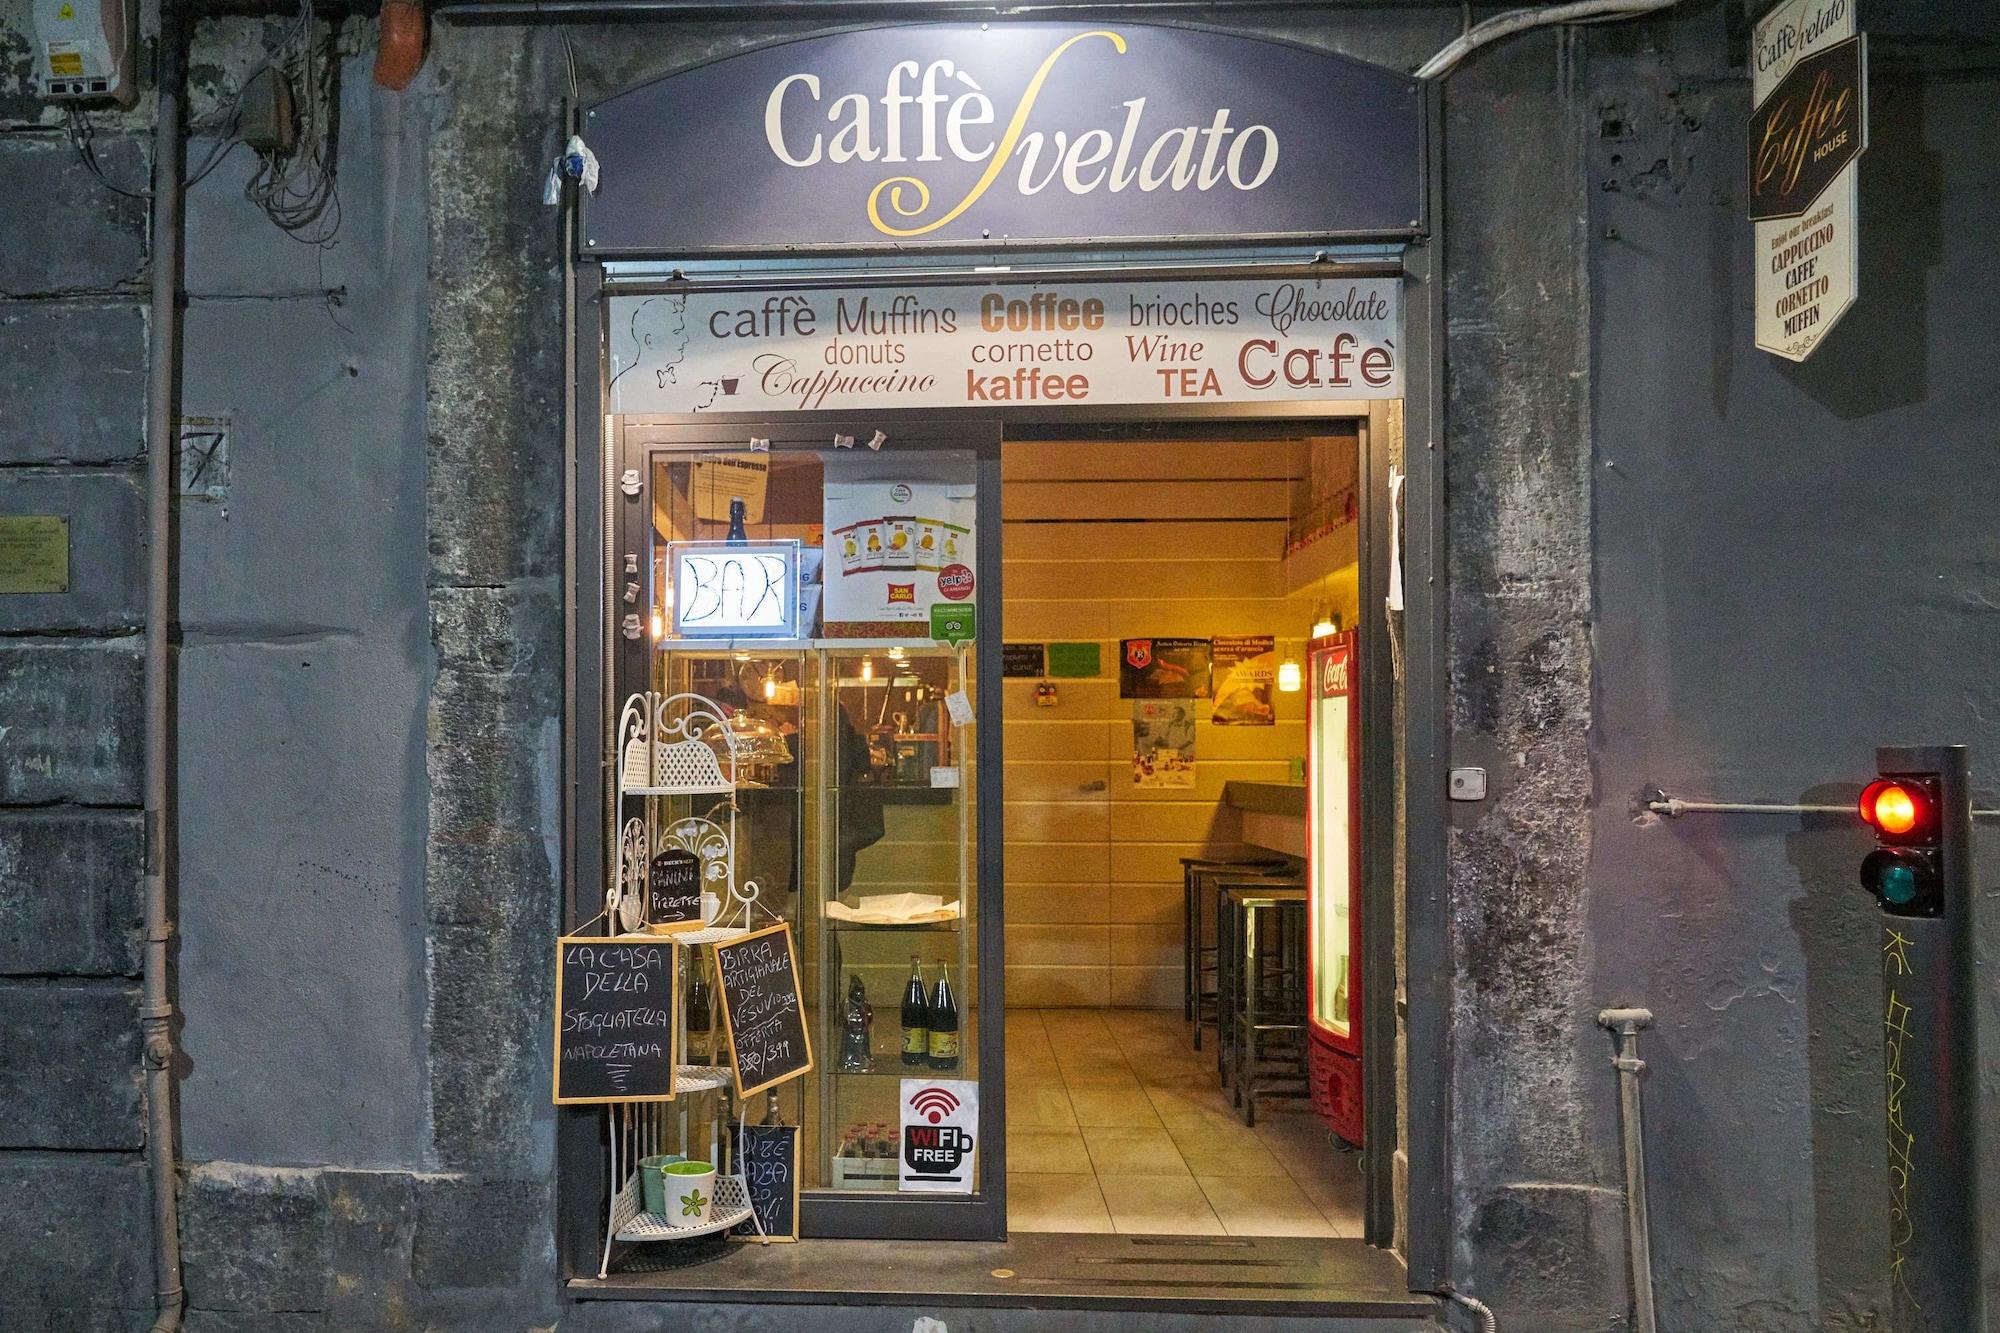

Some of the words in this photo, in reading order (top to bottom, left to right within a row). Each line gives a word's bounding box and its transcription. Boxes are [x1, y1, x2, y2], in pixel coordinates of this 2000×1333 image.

[1758, 24, 1796, 73] Caffè
[764, 60, 996, 168] Caffè
[867, 30, 1279, 237] Svelato
[1813, 130, 1849, 163] HOUSE
[1788, 224, 1801, 241] our
[1801, 203, 1834, 233] breakfast
[1771, 223, 1834, 275] CAPPUCCINO
[1785, 256, 1819, 290] CAFFE'
[709, 295, 816, 339] caffè
[836, 296, 958, 335] Muffins
[980, 293, 1104, 333] Coffee
[1130, 294, 1239, 327] brioches
[1255, 283, 1389, 338] Chocolate
[1775, 274, 1829, 319] CORNETTO
[1784, 303, 1820, 339] MUFFIN
[824, 337, 905, 365] donuts
[971, 338, 1093, 363] cornetto
[1125, 335, 1204, 362] Wine
[1238, 333, 1394, 390] Cafè
[752, 353, 939, 409] Cappuccino
[967, 367, 1089, 401] kaffee
[1157, 368, 1222, 397] TEA
[682, 556, 787, 623] BAR
[893, 587, 909, 595] SAN
[940, 575, 963, 587] yelp
[1233, 670, 1274, 678] AWARDS
[566, 946, 594, 969] LA
[721, 942, 772, 970] BIRRA
[724, 952, 789, 989] ARTIGIANALE
[584, 972, 648, 1000] DELLA
[738, 985, 763, 1006] DEL
[733, 992, 781, 1029] VESUVIO
[564, 1042, 662, 1061] NAPOLETANA
[736, 1018, 783, 1050] OFFERTA
[910, 1128, 958, 1147] WIFI
[913, 1148, 955, 1163] FREE
